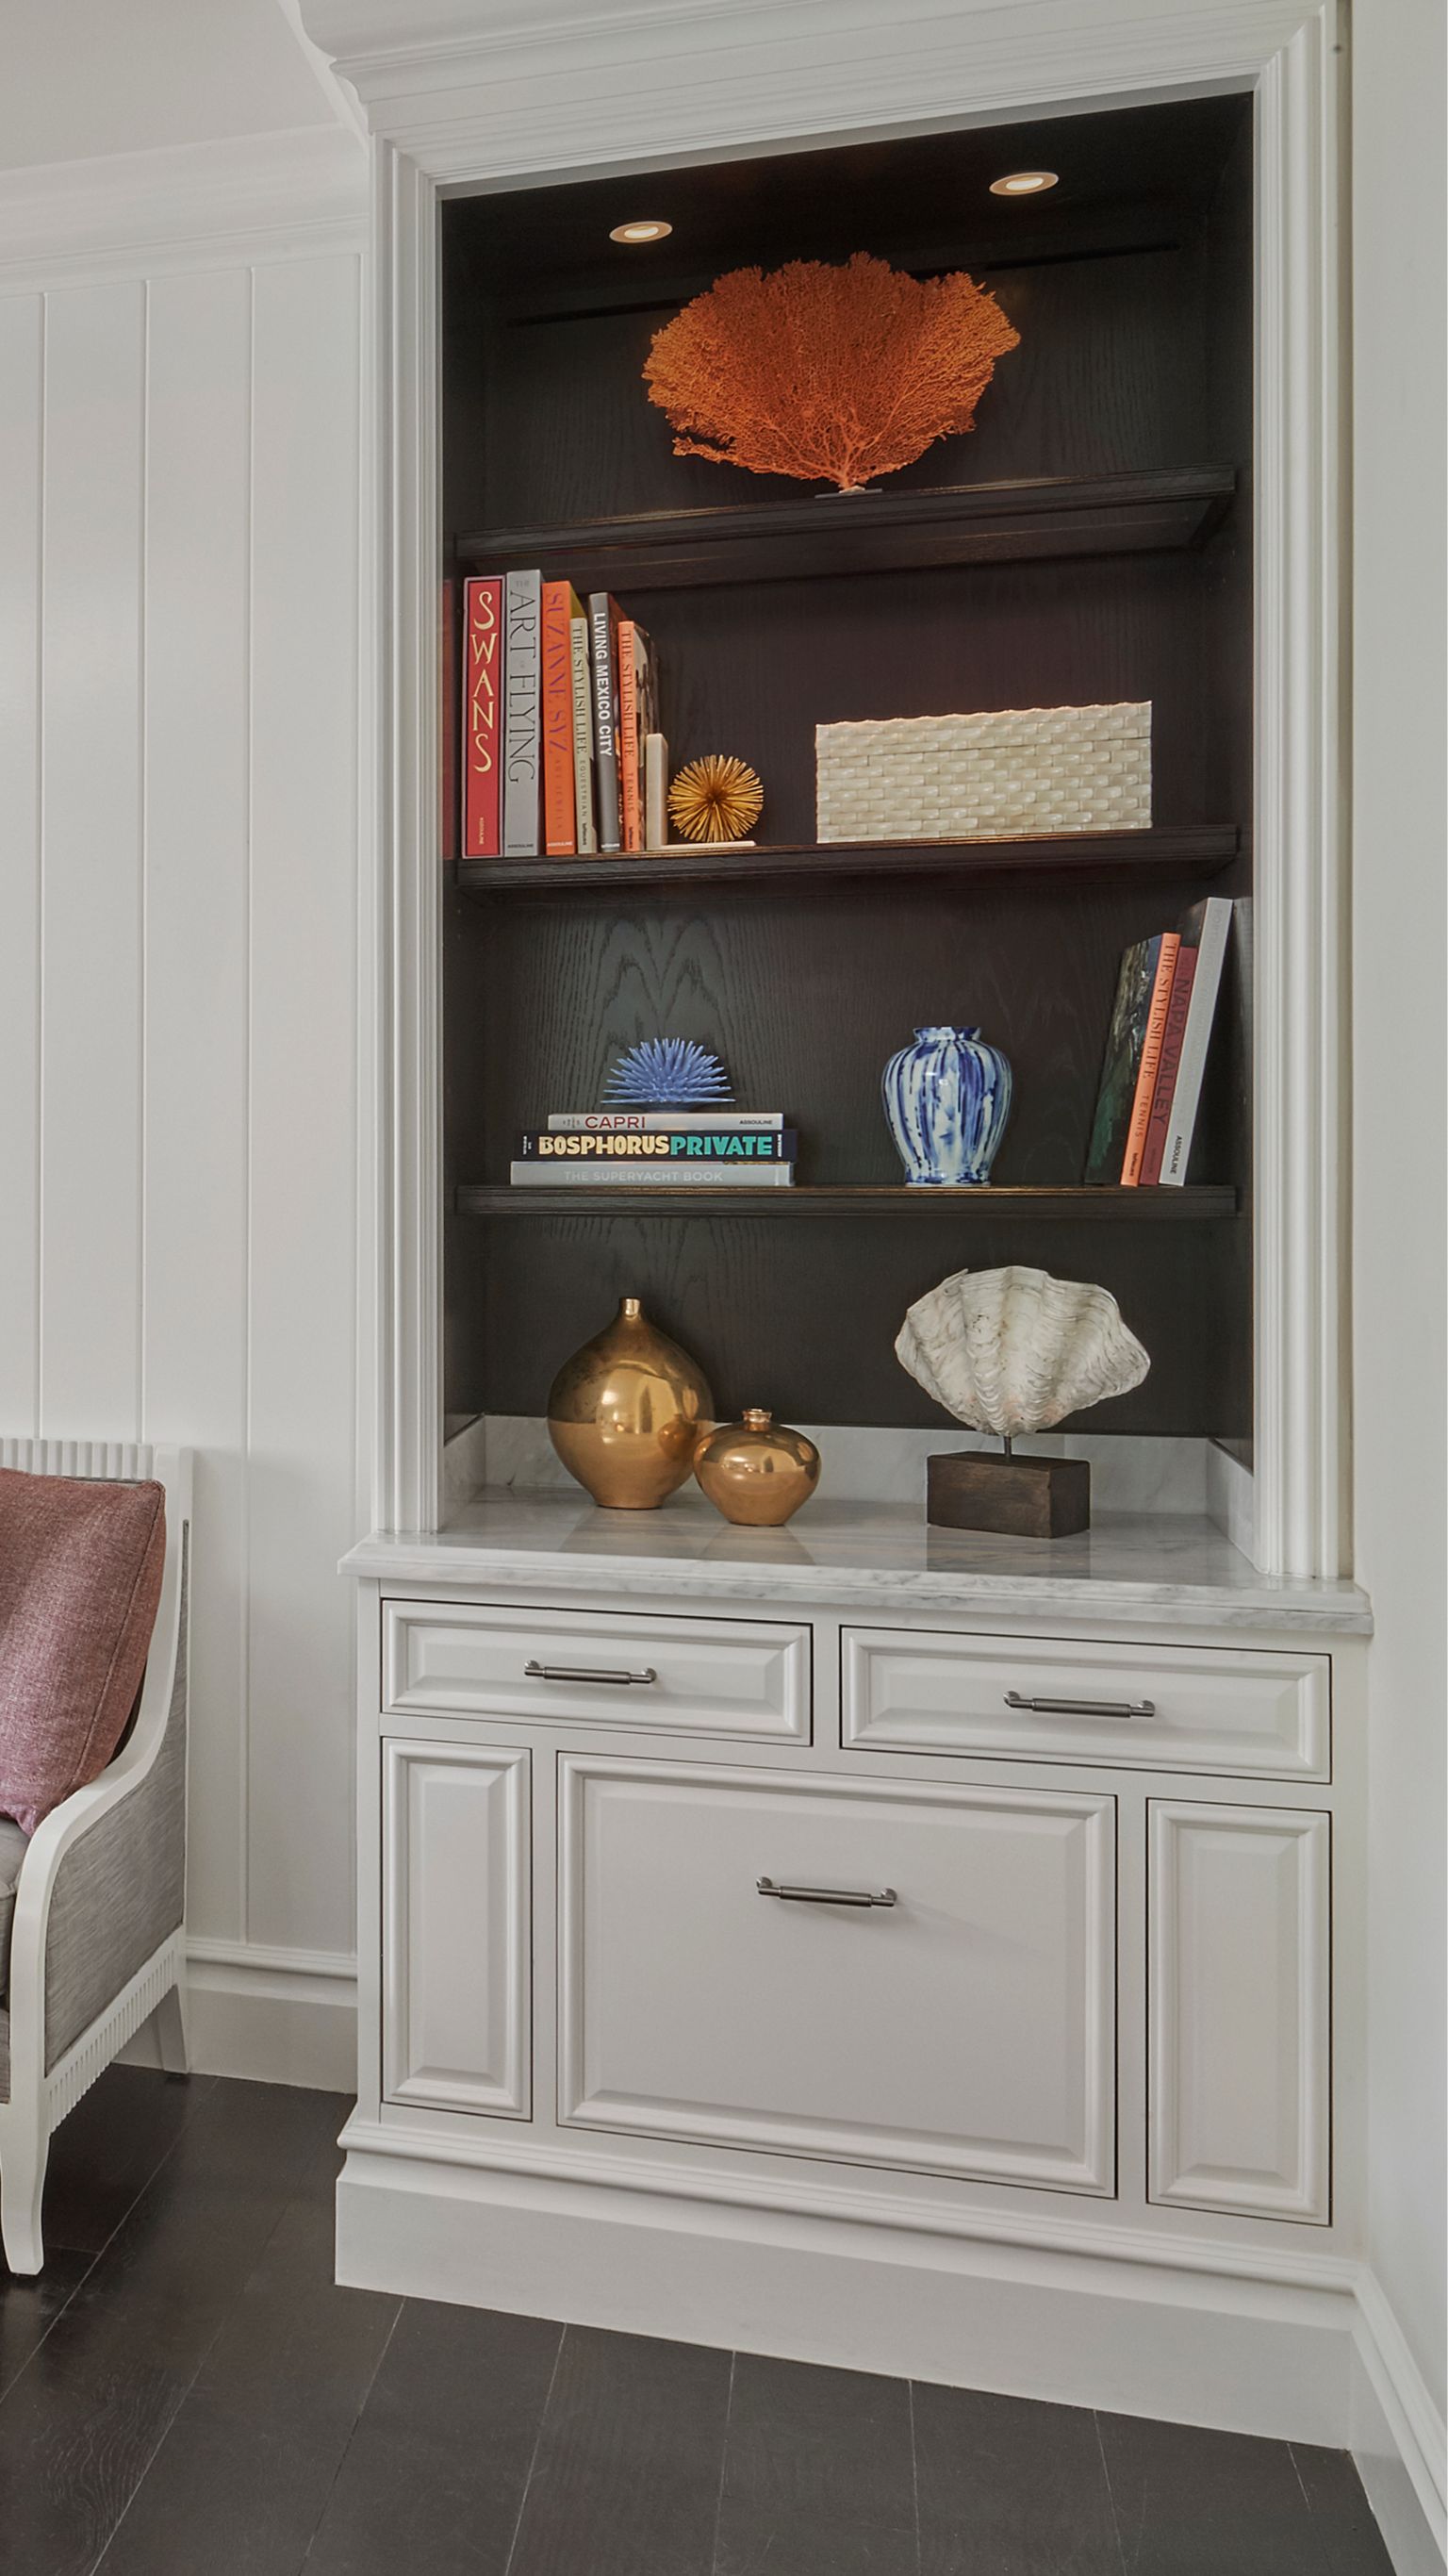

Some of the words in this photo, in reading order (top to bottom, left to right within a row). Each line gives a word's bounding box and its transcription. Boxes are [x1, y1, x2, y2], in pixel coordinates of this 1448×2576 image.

[510, 590, 536, 658] ART
[572, 625, 583, 652] THE
[594, 613, 609, 659] LIVING
[621, 631, 632, 656] THE
[545, 592, 567, 704] SUZANNE
[470, 591, 498, 772] SWANS
[573, 659, 585, 718] STYLISH
[596, 664, 611, 720] MEXICO
[622, 664, 634, 720] STYLISH
[508, 673, 536, 783] FLYING
[549, 709, 568, 753] SYZ
[576, 721, 587, 754] LIFE
[599, 726, 613, 756] CITY
[623, 724, 635, 758] LIFE
[580, 759, 588, 817] EQUESTRIAN
[626, 773, 634, 812] TENNIS
[1160, 943, 1177, 973] THE
[1149, 978, 1172, 1040] STYLISH
[1167, 979, 1191, 1036] NAPA
[1143, 1045, 1159, 1079] LIFE
[1153, 1046, 1177, 1124] VALLEY
[584, 1116, 646, 1129] CAPRI
[1135, 1095, 1149, 1137] TENNIS
[538, 1135, 669, 1155] BOSPHORUS
[670, 1136, 772, 1155] PRIVATE
[1170, 1135, 1182, 1175] ASSOULINE
[564, 1171, 589, 1181] THE
[593, 1171, 680, 1181] SUPERYACHT
[683, 1171, 723, 1181] BOOK
